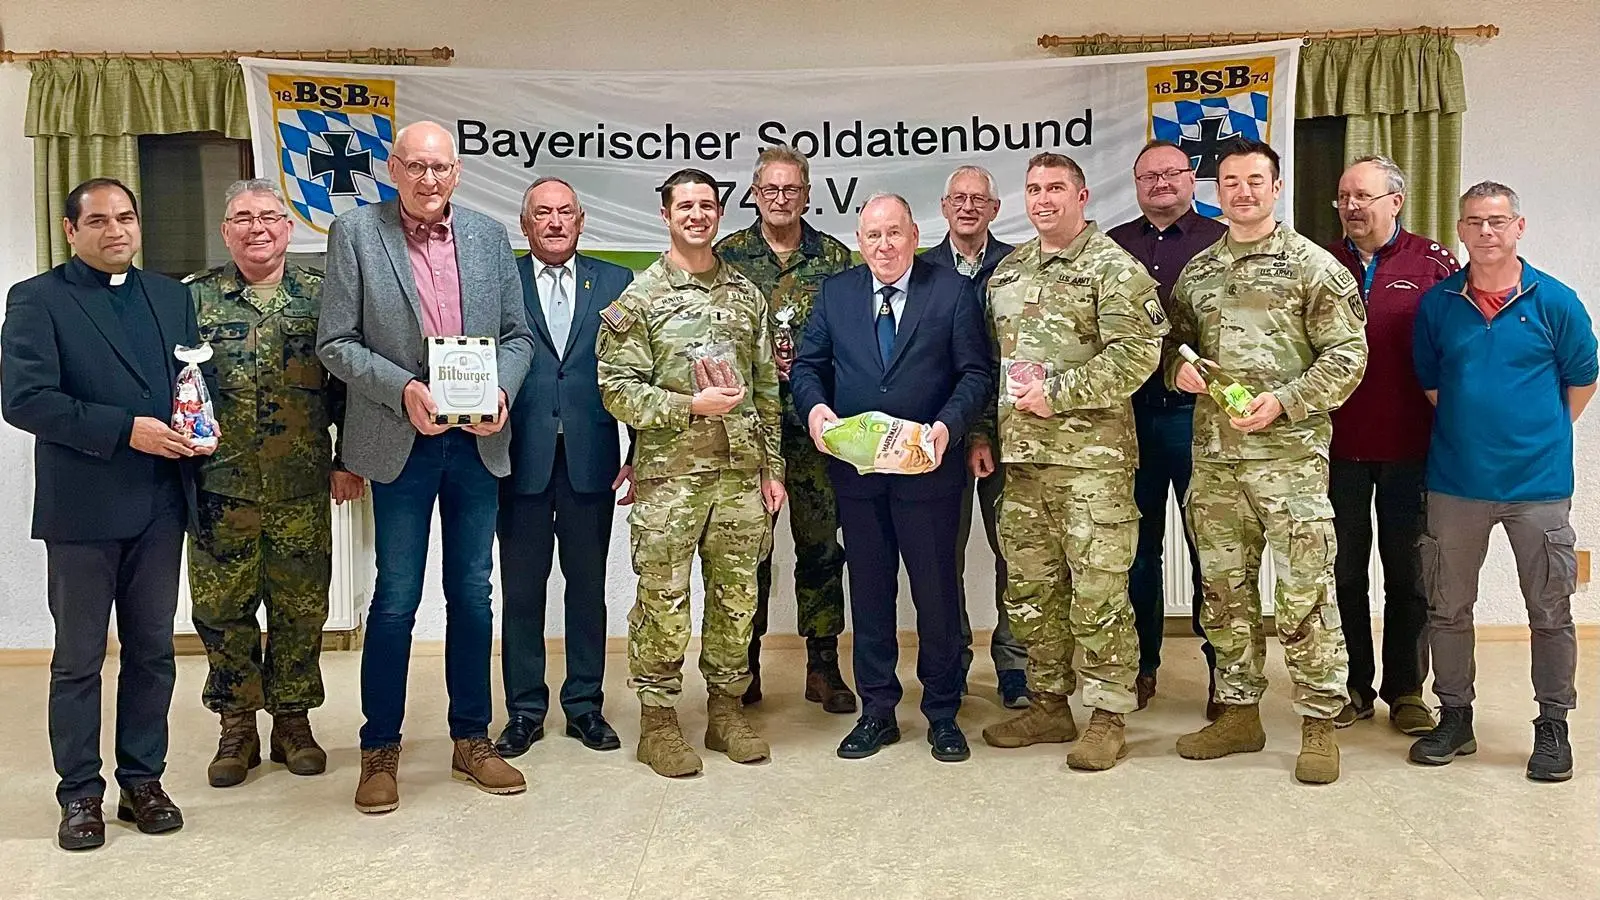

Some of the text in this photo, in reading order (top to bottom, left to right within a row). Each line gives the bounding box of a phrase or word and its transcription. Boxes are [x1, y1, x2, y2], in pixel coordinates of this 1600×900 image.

[1154, 65, 1269, 94] 18 BSB 74
[275, 81, 389, 109] 18 BSB 74
[457, 108, 1093, 168] Bayerischer Soldatenbund
[655, 181, 761, 216] 74
[438, 365, 491, 383] Bitburger
